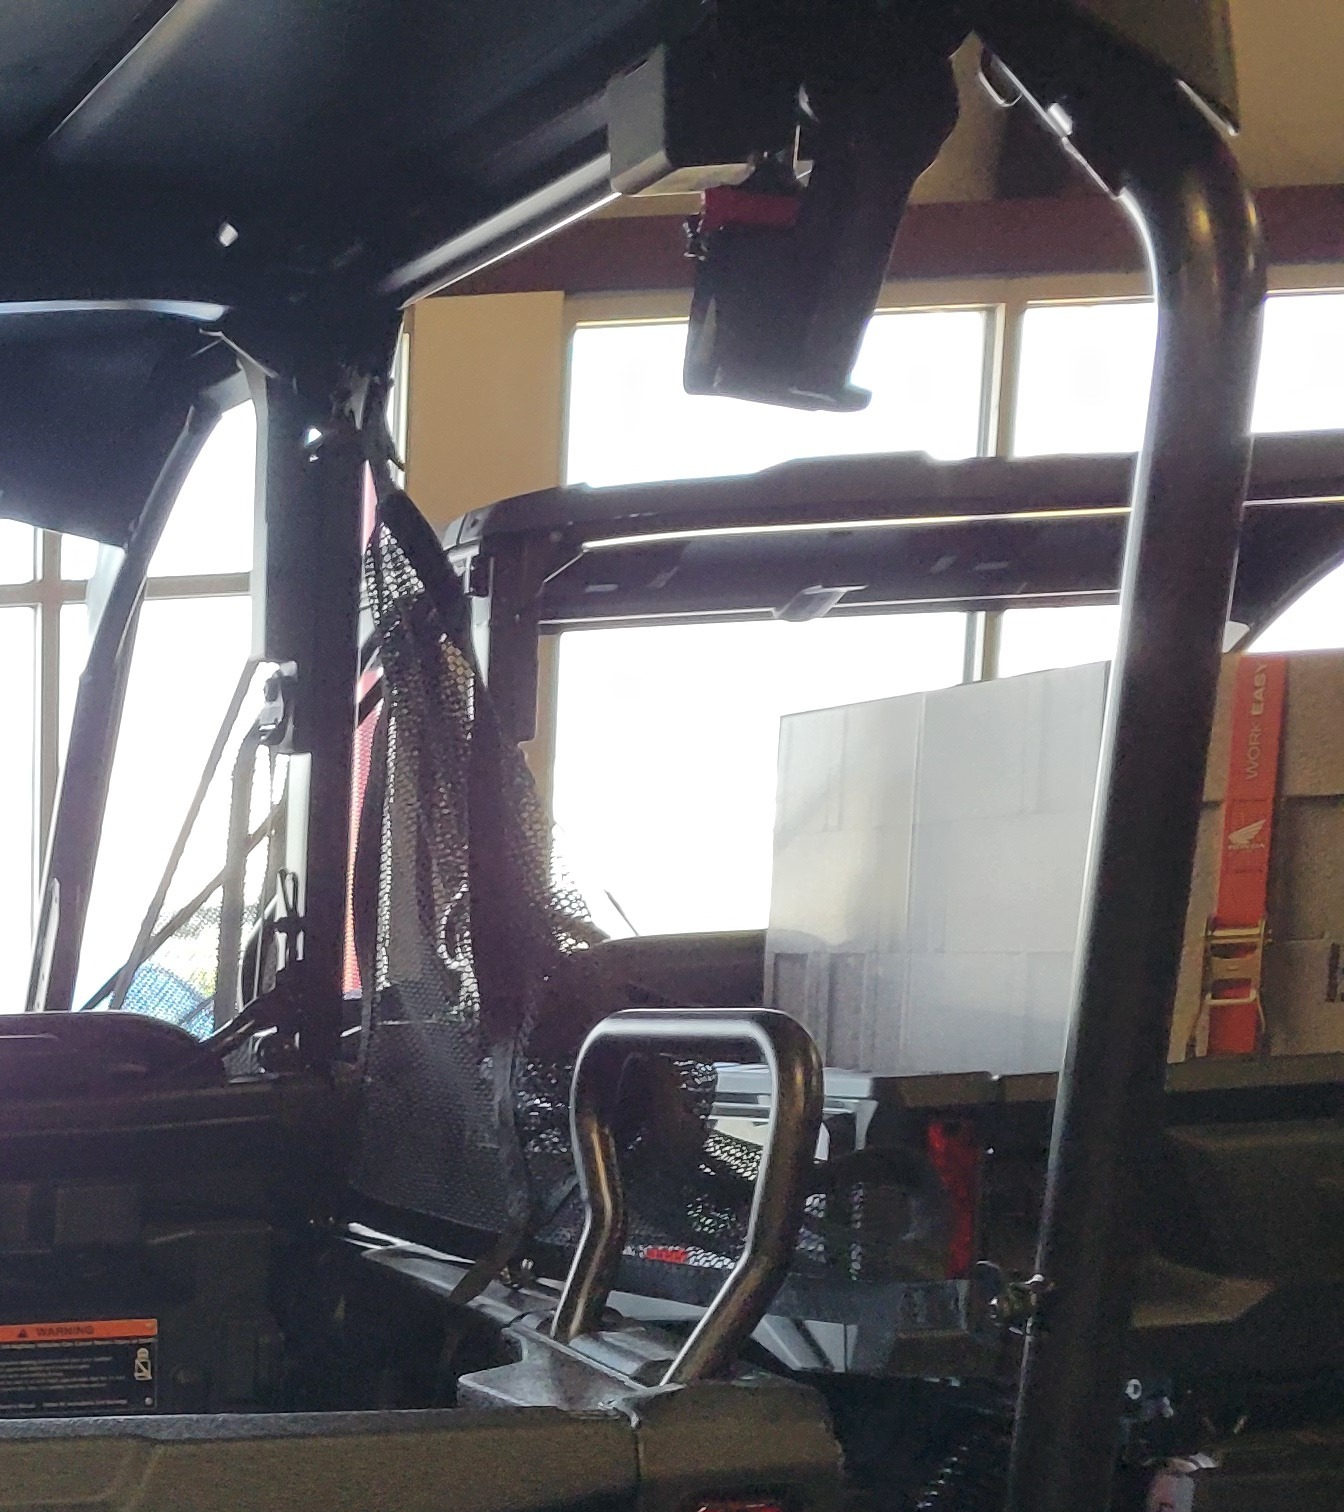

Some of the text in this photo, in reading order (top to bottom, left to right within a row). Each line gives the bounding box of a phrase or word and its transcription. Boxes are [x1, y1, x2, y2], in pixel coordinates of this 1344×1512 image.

[1245, 662, 1267, 780] WORK EASY
[36, 1325, 94, 1337] WARNING
